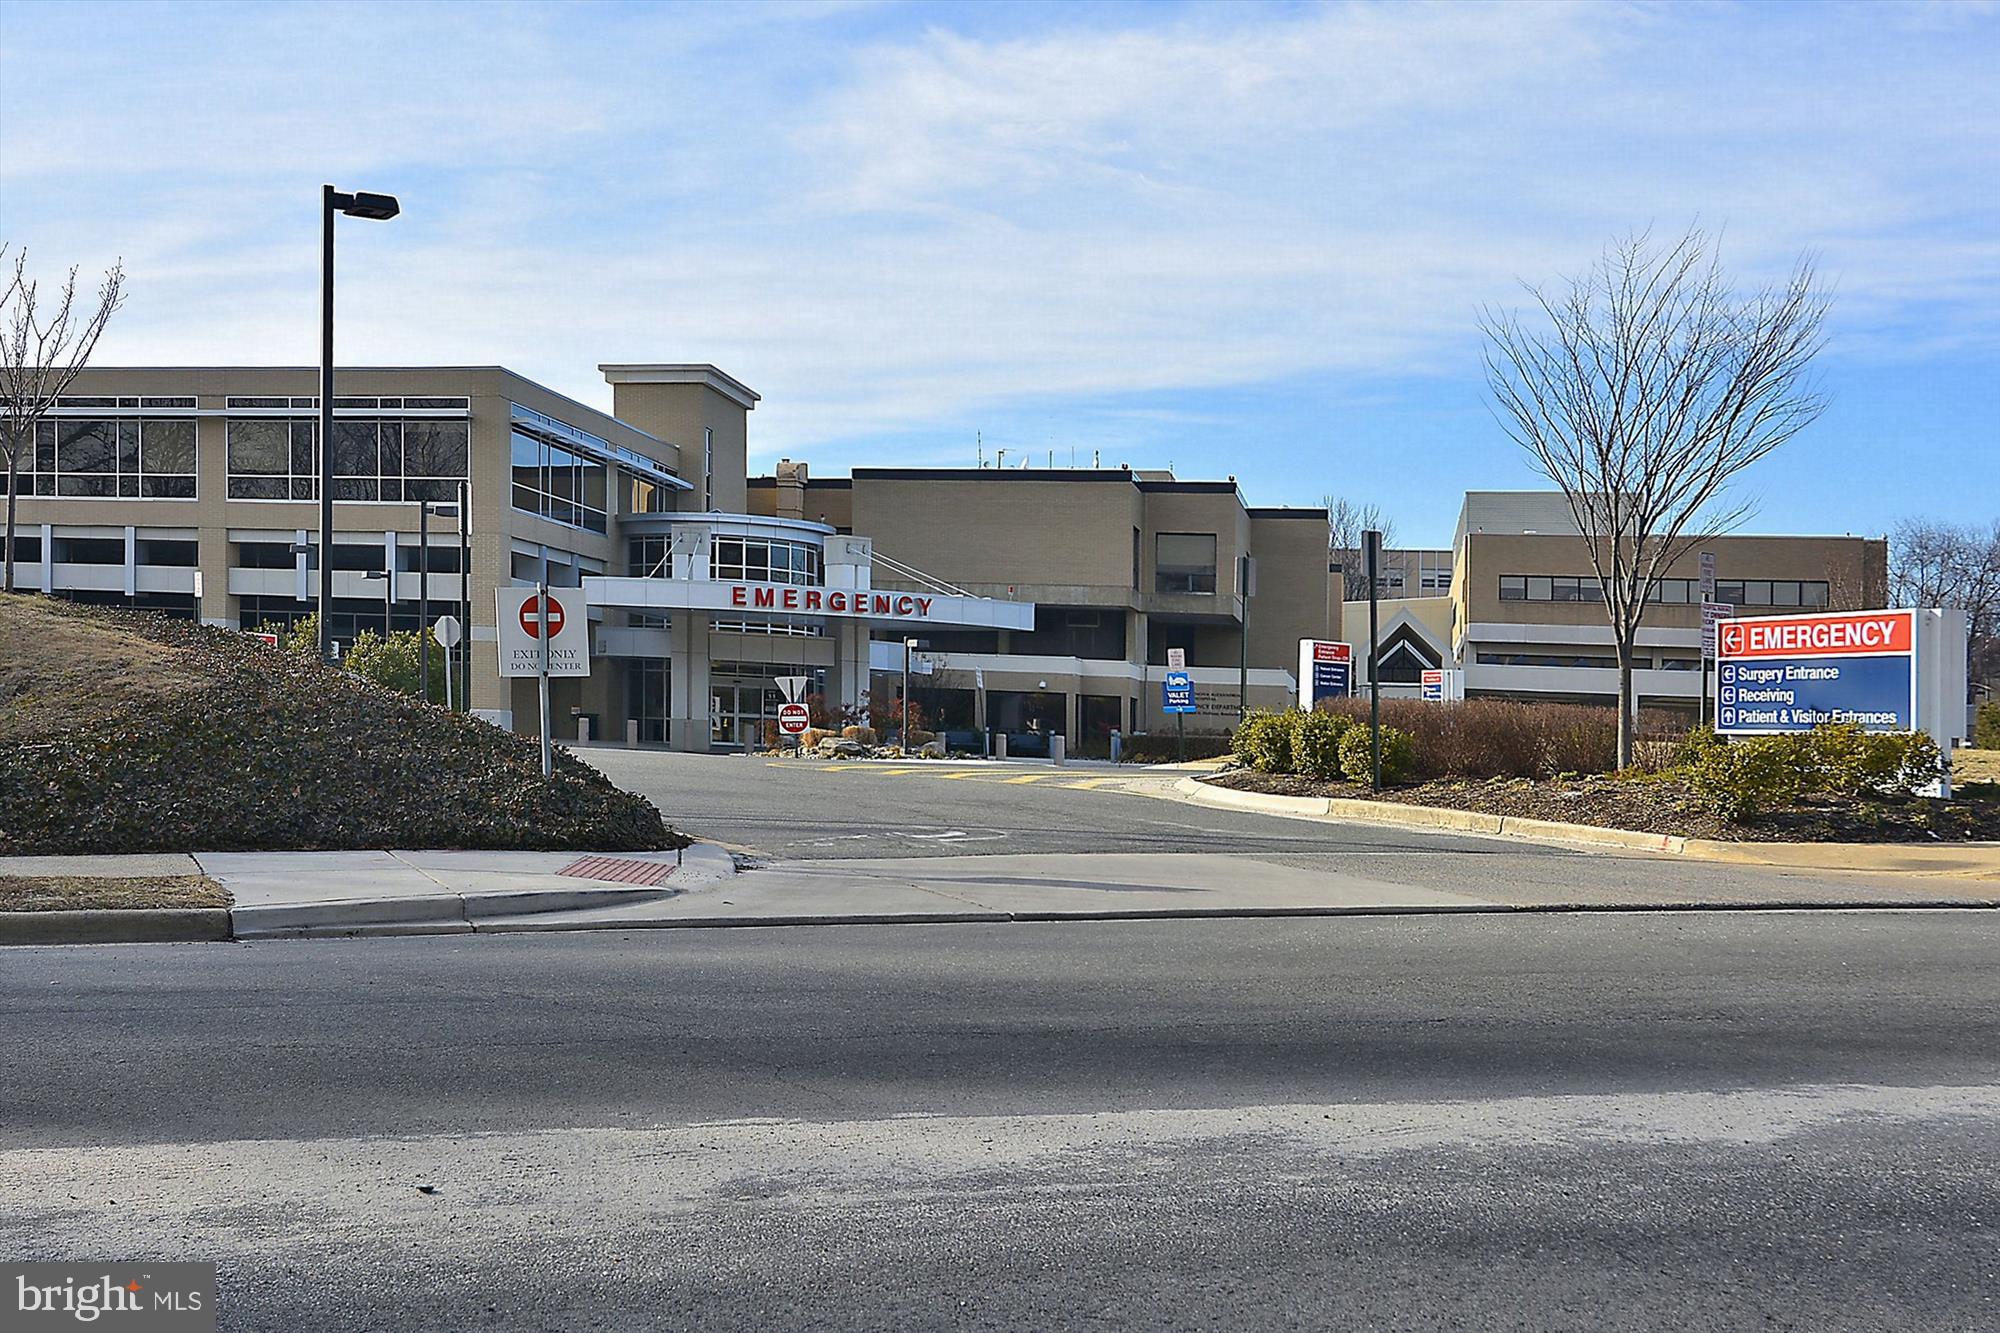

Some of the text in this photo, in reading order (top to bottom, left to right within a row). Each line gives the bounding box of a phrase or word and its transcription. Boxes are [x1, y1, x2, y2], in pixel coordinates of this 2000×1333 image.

[732, 586, 932, 616] EMERGENCY
[1750, 621, 1896, 650] EMERGENCY
[513, 650, 540, 659] EXIT
[1738, 666, 1839, 684] Surgery Entrance
[1738, 688, 1794, 704] Receiving
[1738, 708, 1897, 724] Patient & Visitor Entrances
